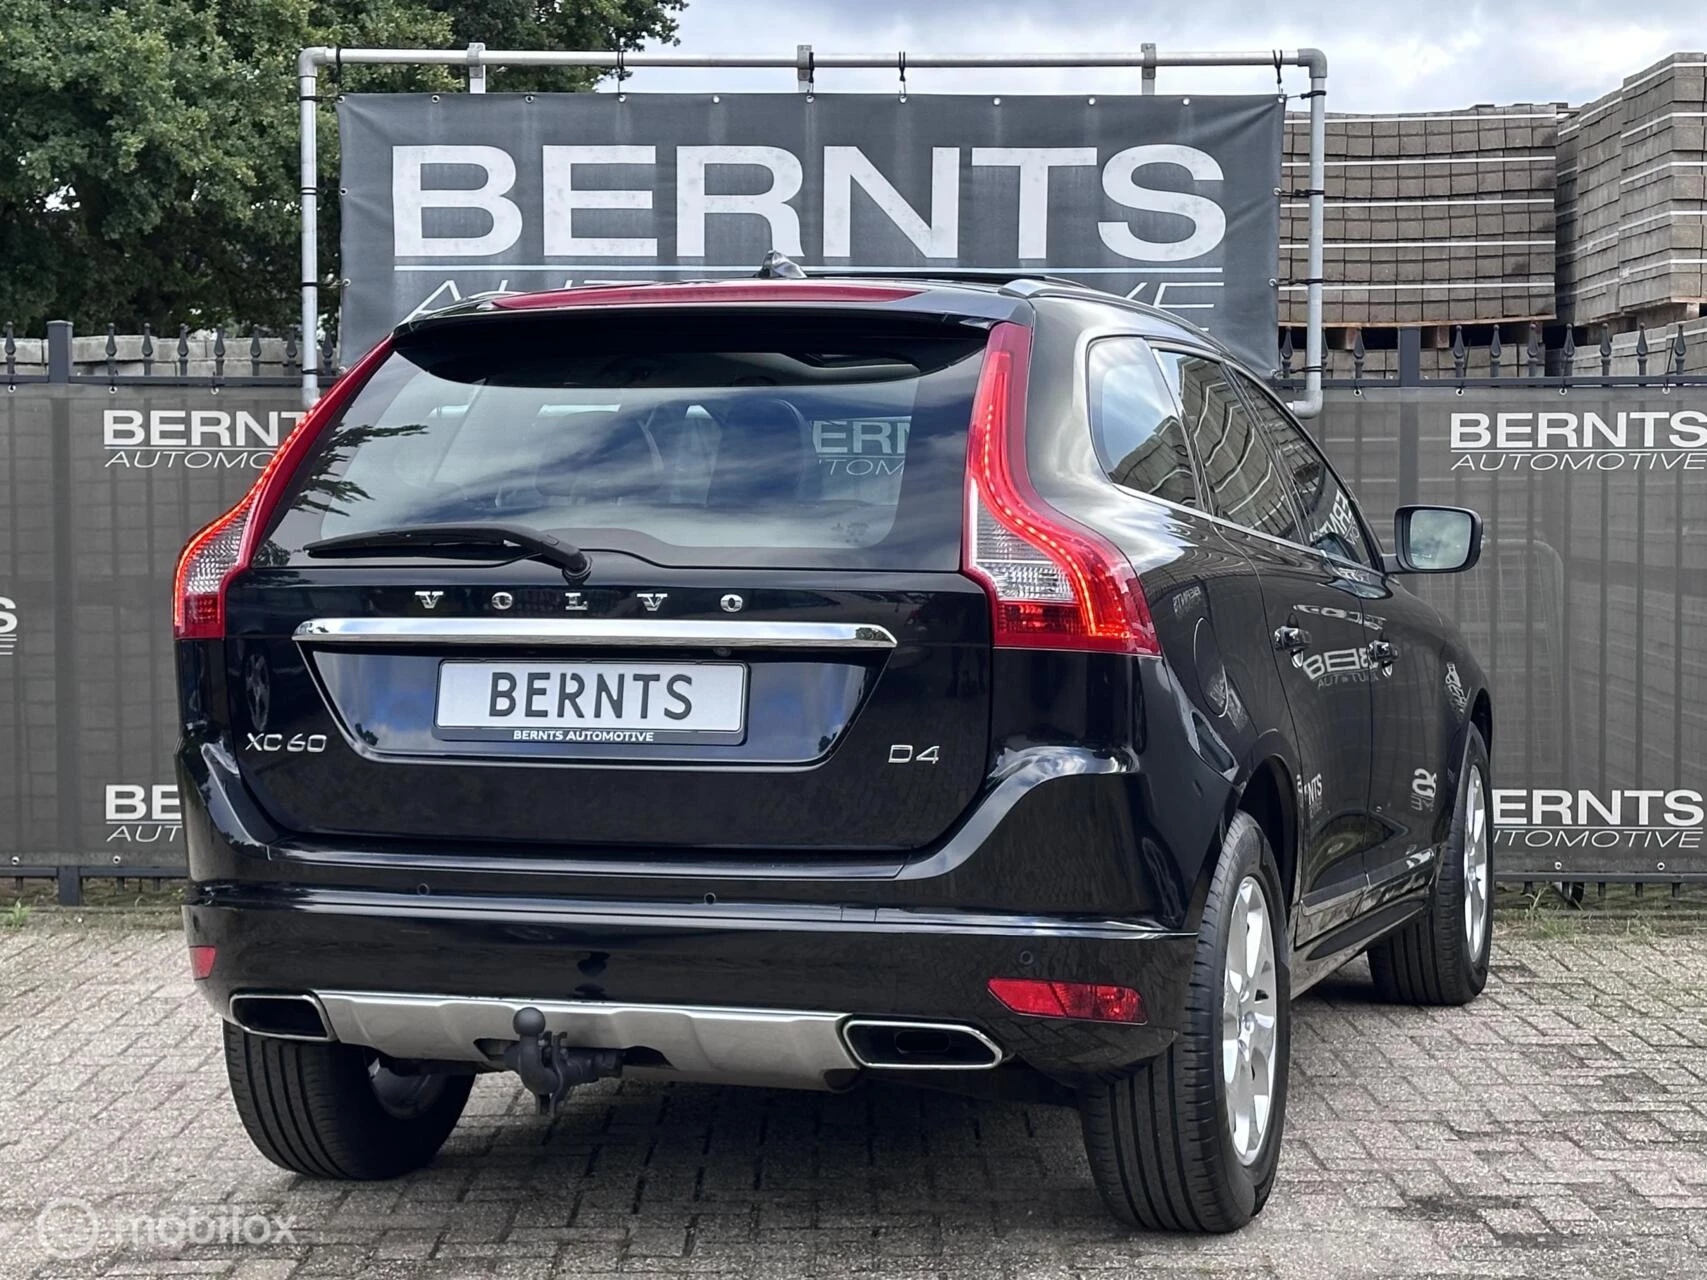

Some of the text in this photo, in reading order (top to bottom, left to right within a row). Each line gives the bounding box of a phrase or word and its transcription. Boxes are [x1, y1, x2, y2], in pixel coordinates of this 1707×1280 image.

[392, 144, 1227, 261] BERNTS
[1450, 411, 1707, 448] BERNTS
[818, 459, 905, 475] TOM
[1450, 453, 1706, 470] AUTOMOTIVE
[415, 591, 743, 613] VOLVO
[489, 672, 692, 720] BERNTS
[245, 733, 327, 752] XC60
[513, 730, 654, 742] BERNTS AUTOMOTIVE
[888, 744, 940, 764] D4
